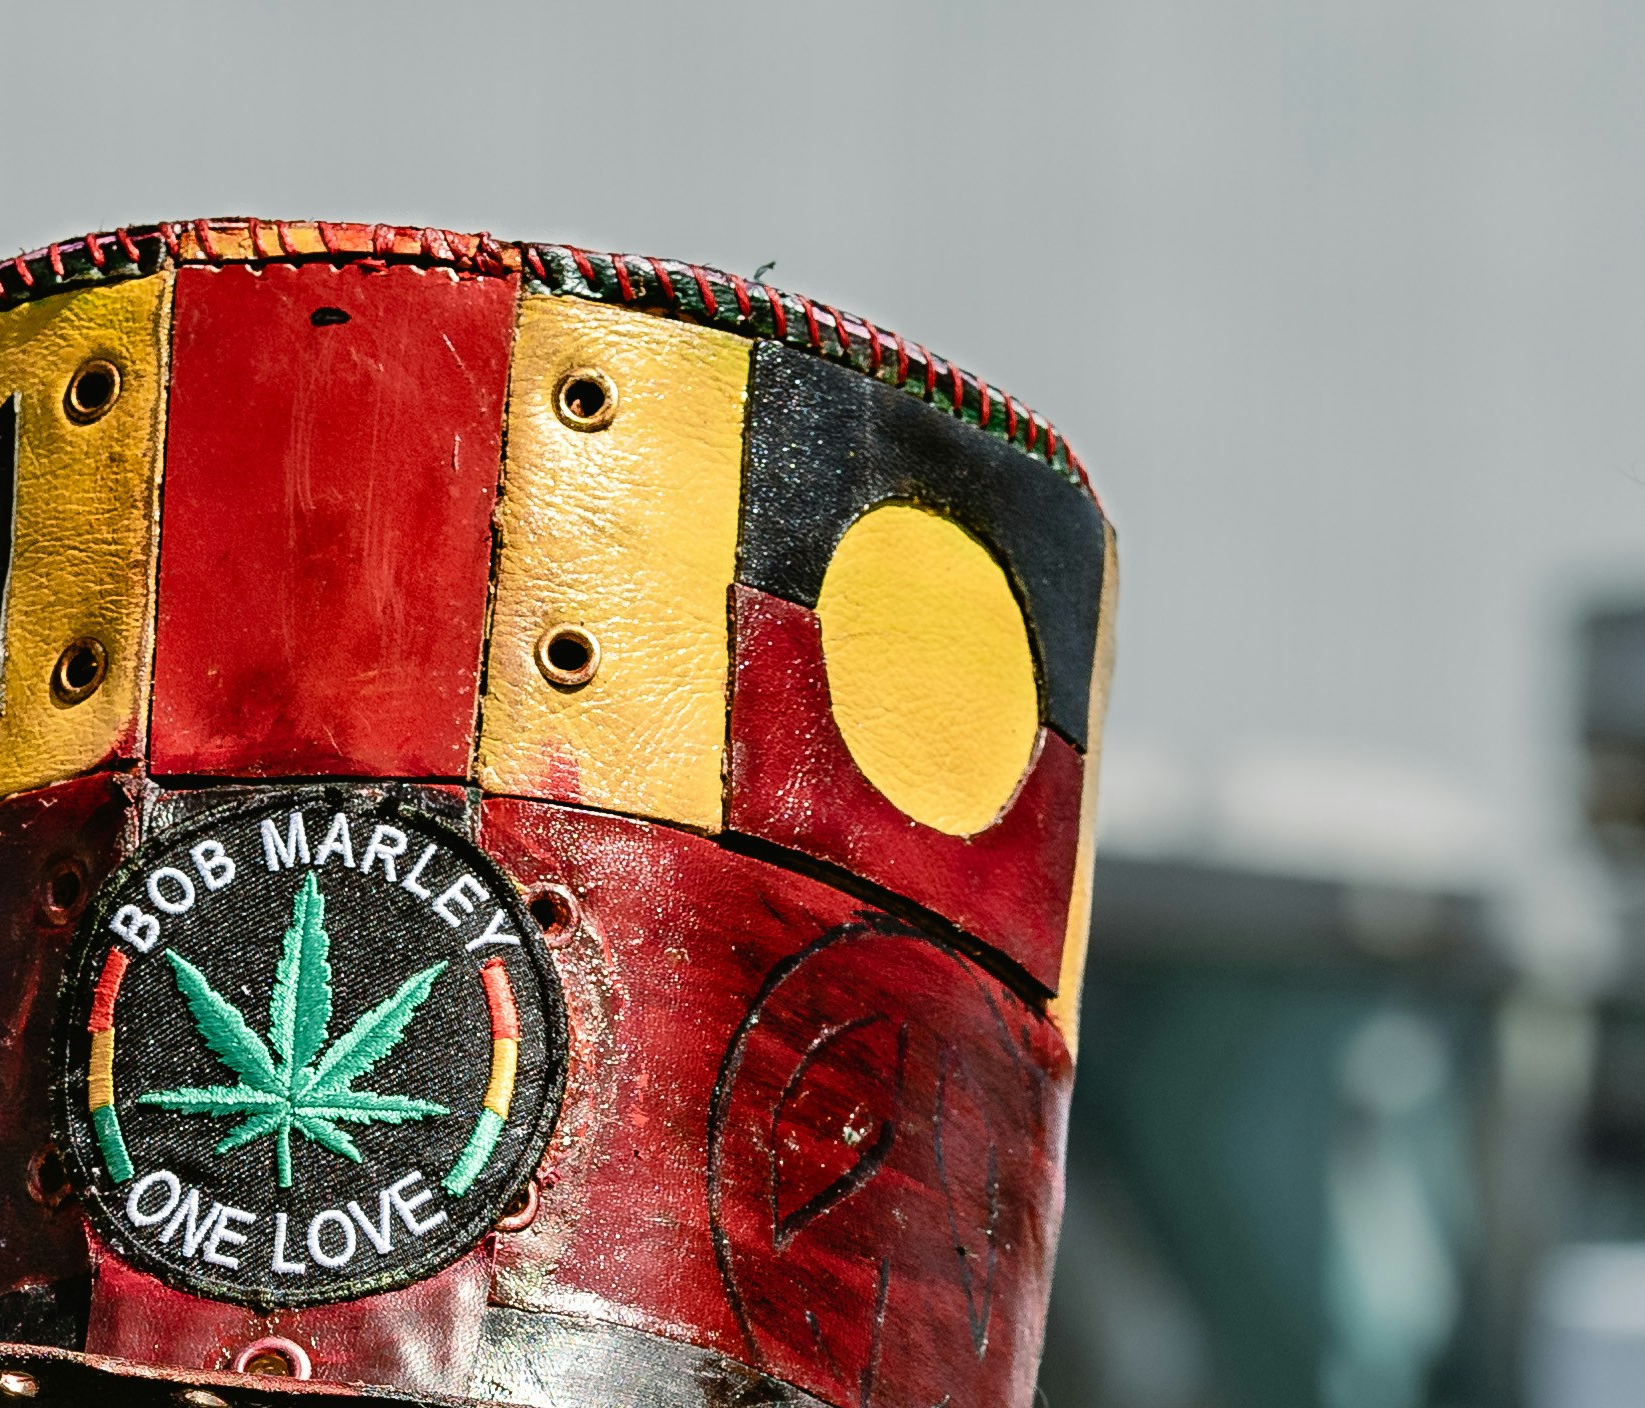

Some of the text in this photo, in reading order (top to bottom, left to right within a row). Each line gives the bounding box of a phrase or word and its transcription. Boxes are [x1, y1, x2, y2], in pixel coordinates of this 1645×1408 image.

[110, 812, 520, 953] BOB MARLEY
[127, 1170, 448, 1274] ONE LOVE
